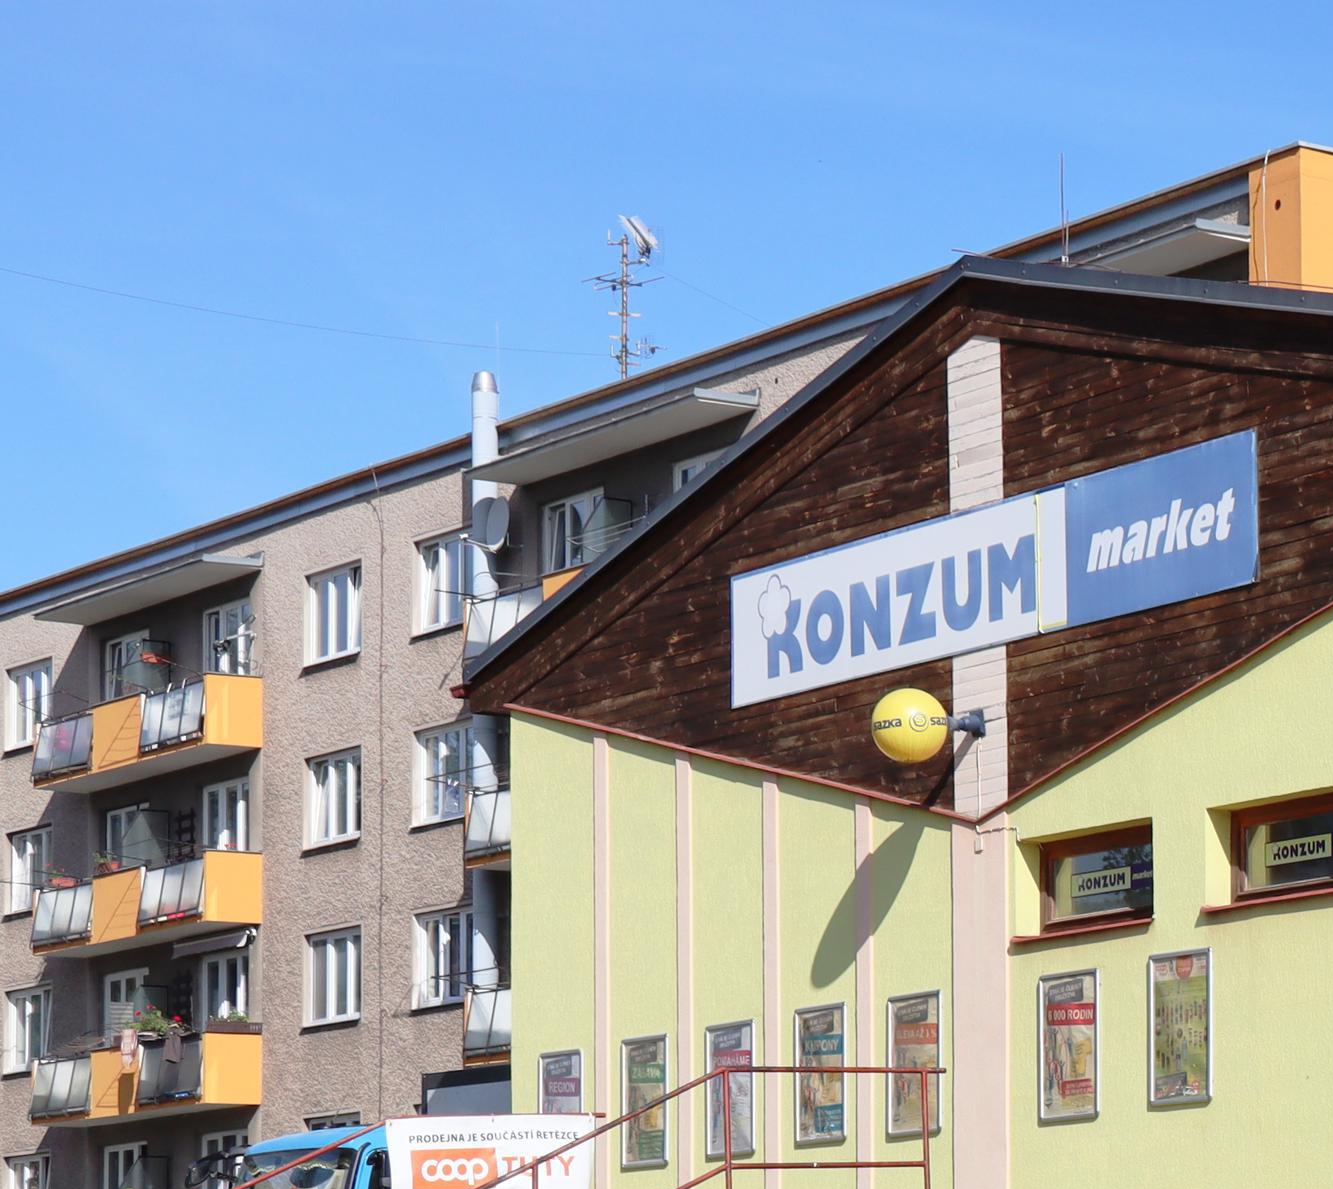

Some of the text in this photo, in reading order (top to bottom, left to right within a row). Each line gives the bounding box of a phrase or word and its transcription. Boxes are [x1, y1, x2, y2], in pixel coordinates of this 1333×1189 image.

[767, 487, 1235, 679] KONZUM market
[1067, 1008, 1094, 1020] RODIN
[549, 1081, 576, 1093] REGION
[409, 1129, 579, 1144] PRODEJNA JE SOUČÁSTÍ ŘETĚZCE
[421, 1157, 489, 1185] coop
